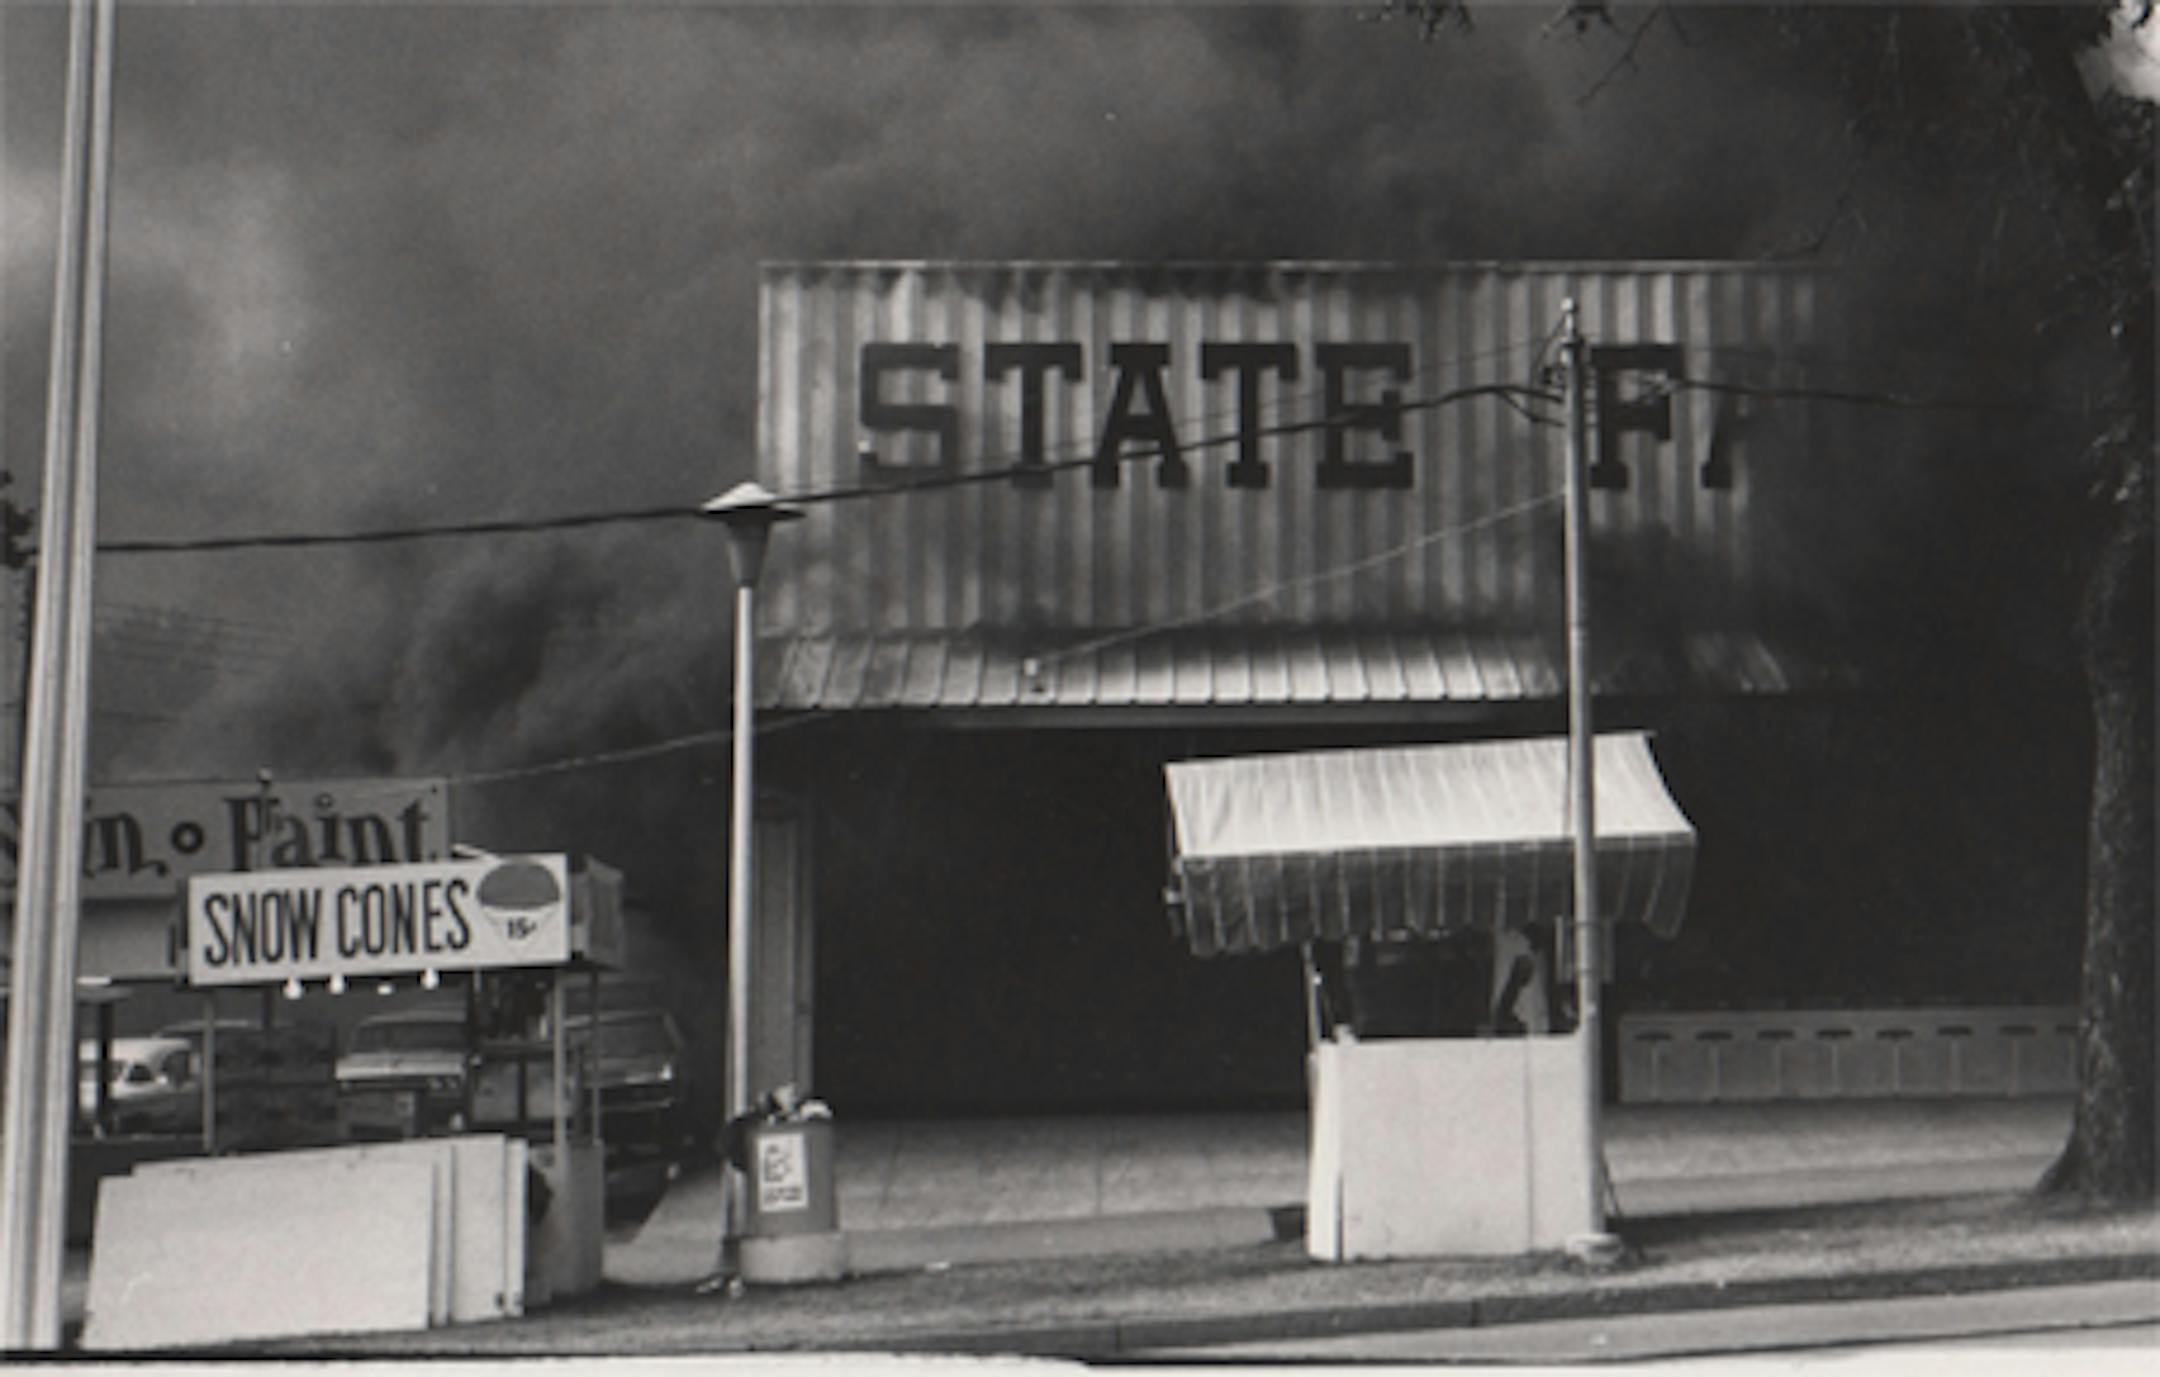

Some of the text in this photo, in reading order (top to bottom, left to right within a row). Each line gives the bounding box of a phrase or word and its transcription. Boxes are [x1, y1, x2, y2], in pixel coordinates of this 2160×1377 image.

[859, 343, 1414, 489] STATE
[204, 878, 470, 967] SNOW CONES
